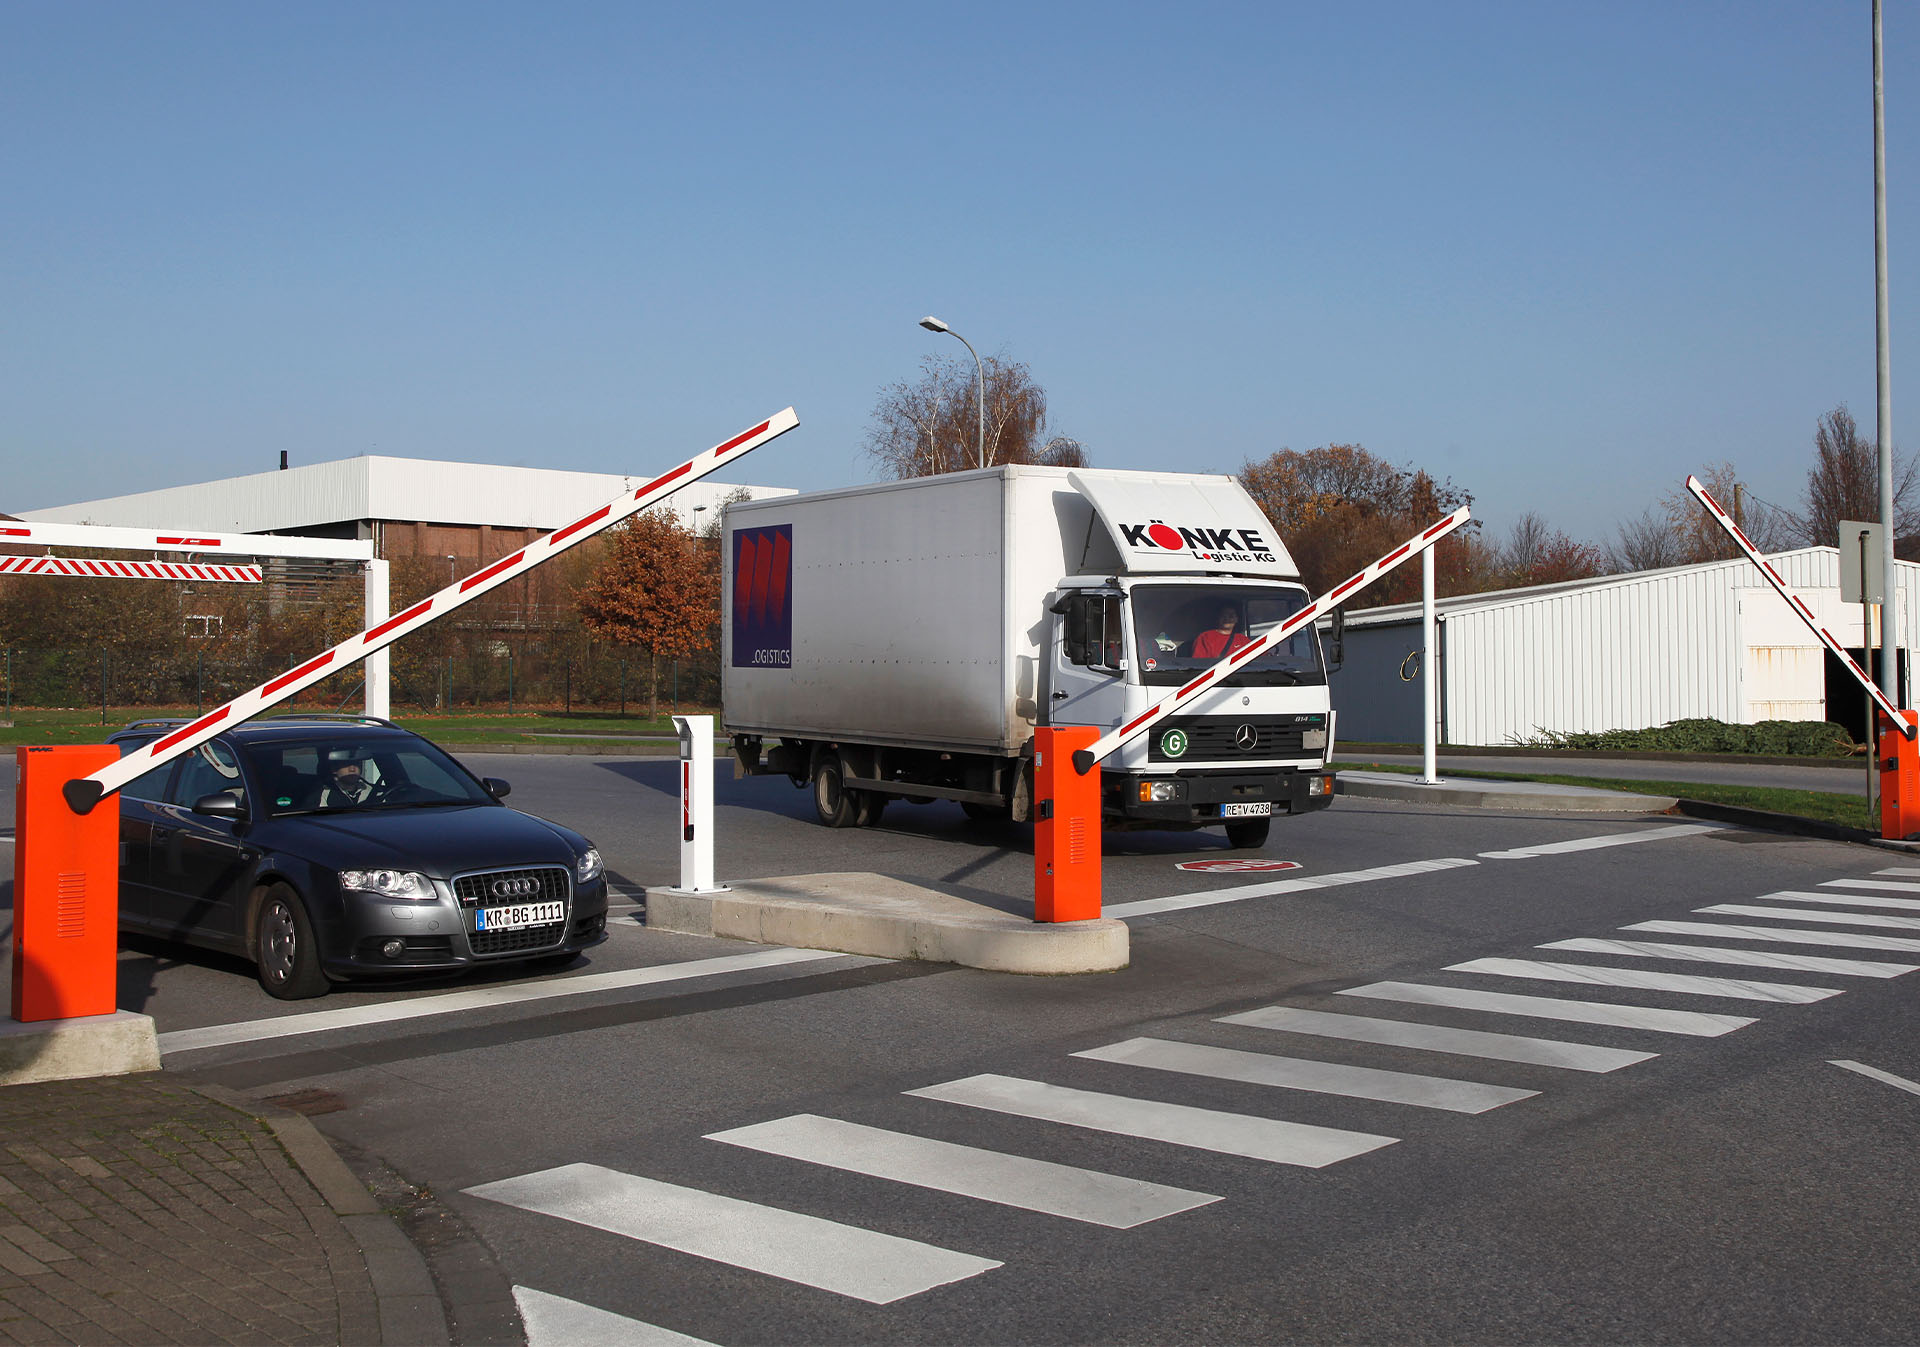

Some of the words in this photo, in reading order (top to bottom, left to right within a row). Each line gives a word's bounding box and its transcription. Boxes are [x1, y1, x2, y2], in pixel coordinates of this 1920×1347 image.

[1118, 519, 1270, 552] KÖNKE
[1192, 551, 1252, 563] Logistic
[1253, 552, 1276, 562] KG
[1169, 734, 1181, 751] G
[1226, 805, 1238, 816] RE
[1243, 805, 1249, 815] V
[1249, 803, 1270, 815] 4738
[486, 910, 503, 928] KR
[512, 907, 529, 924] BG
[531, 903, 563, 922] 1111
